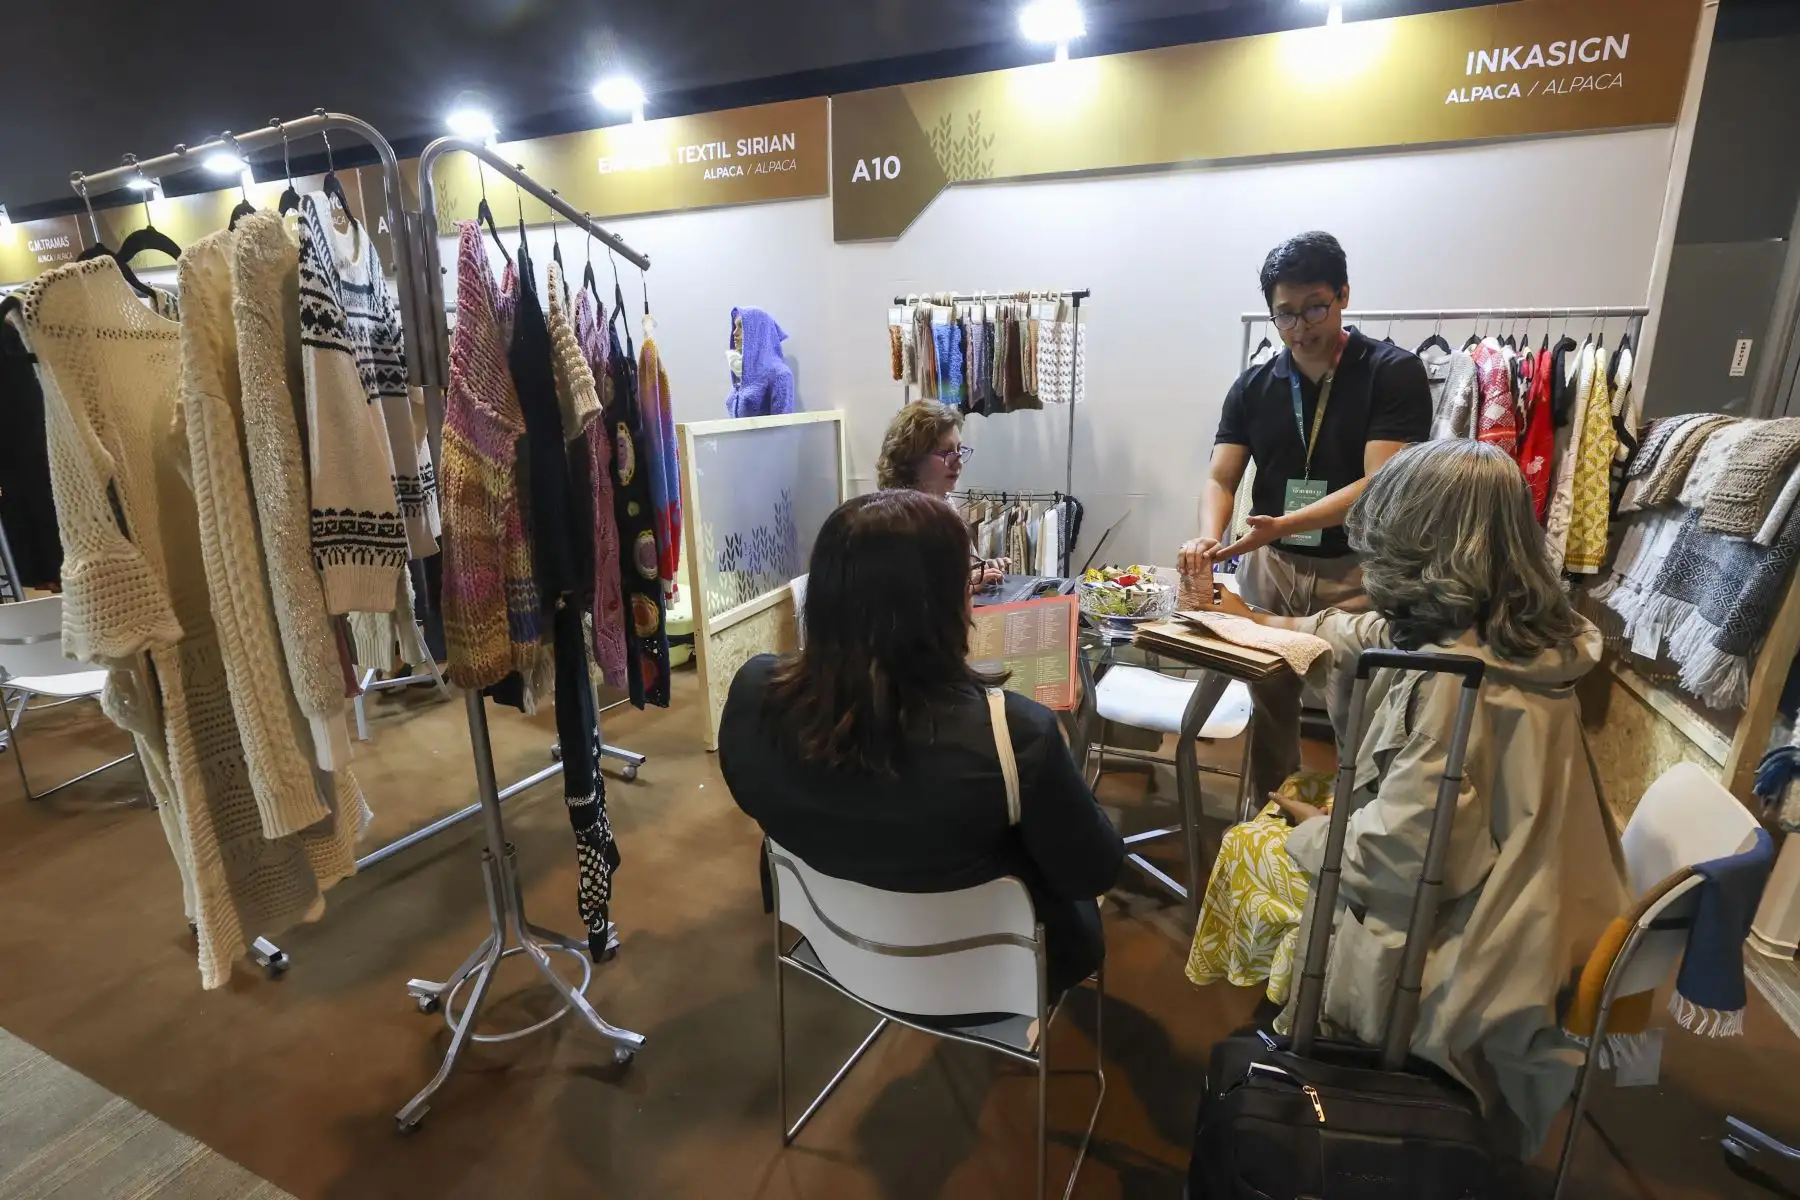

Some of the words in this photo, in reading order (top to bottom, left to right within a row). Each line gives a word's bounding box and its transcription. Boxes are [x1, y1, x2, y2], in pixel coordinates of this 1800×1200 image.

[1465, 33, 1630, 76] INKASIGN
[1444, 82, 1521, 105] ALPACA
[1527, 80, 1540, 97] /
[1542, 72, 1623, 95] ALPACA
[677, 141, 732, 164] TEXTIL
[736, 132, 795, 157] SIRIAN
[703, 164, 744, 180] ALPACA
[754, 158, 797, 175] ALPACA
[851, 155, 901, 183] A10
